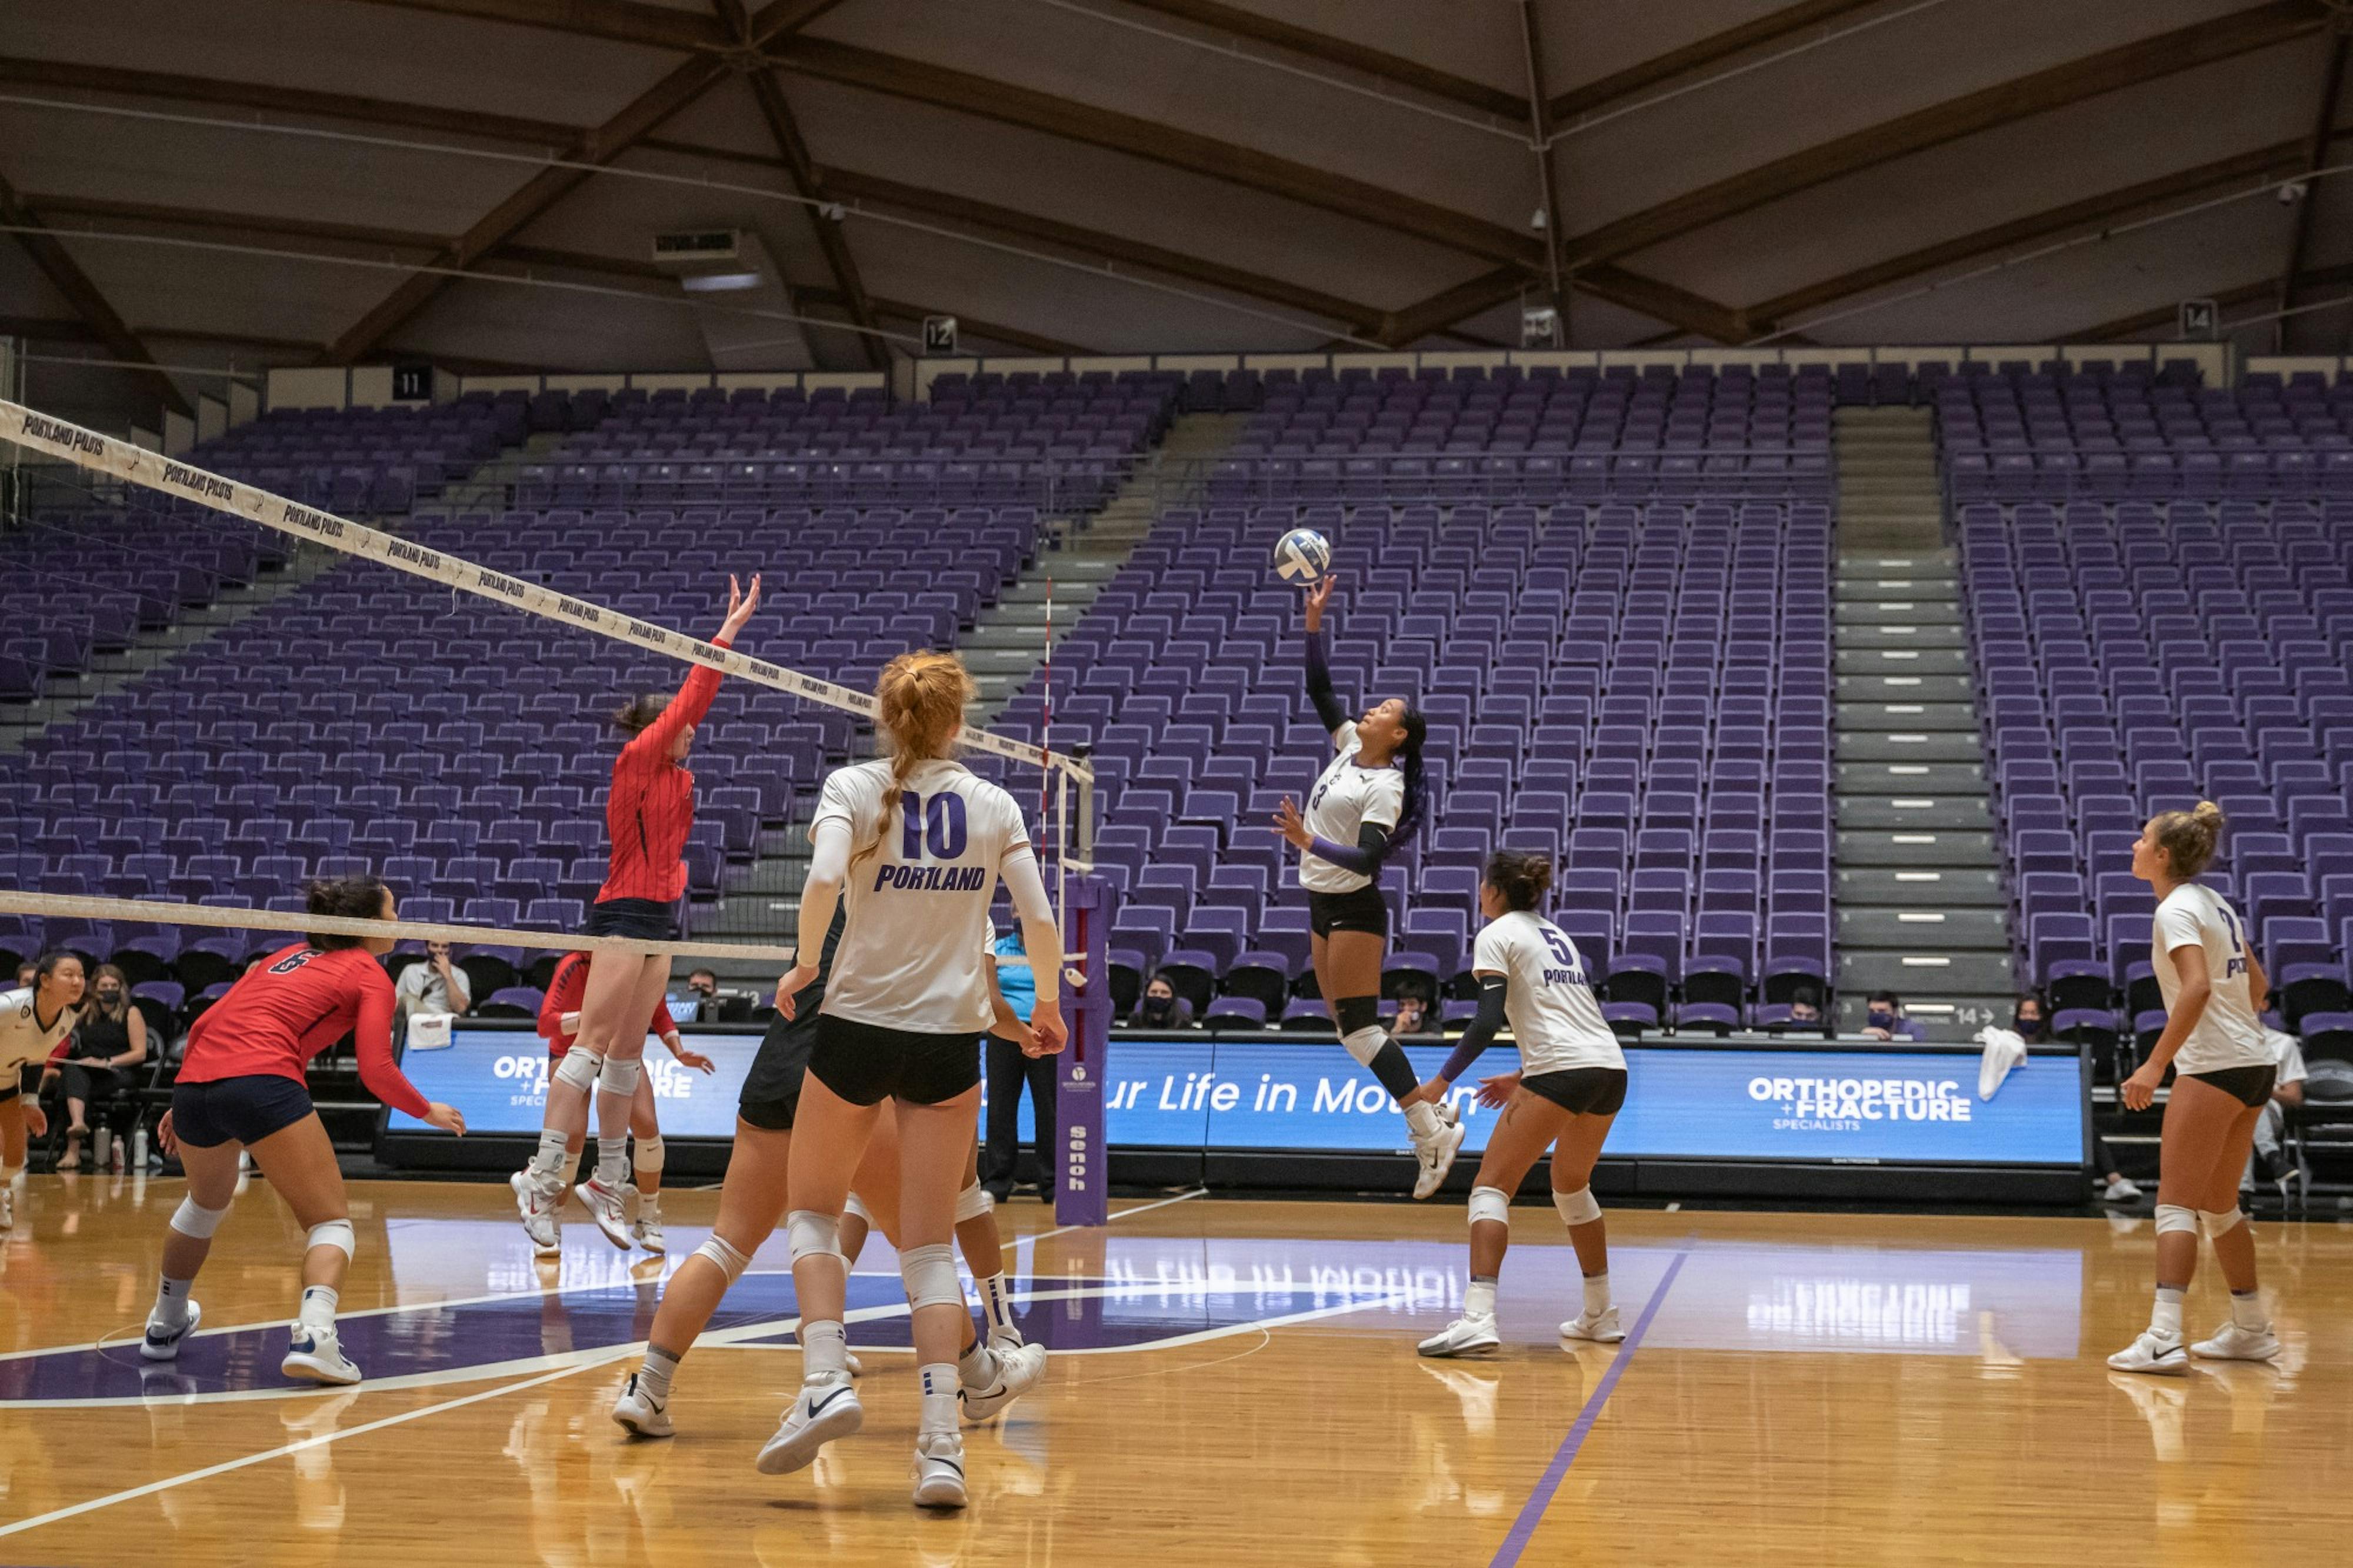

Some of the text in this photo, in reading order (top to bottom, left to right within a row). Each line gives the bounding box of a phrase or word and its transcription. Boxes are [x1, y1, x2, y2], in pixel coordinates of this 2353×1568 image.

[929, 324, 951, 345] 12
[402, 373, 418, 394] 11
[22, 413, 105, 456] PORTLAND PILOTS
[162, 463, 234, 501] PORTLAND PILOTS
[283, 504, 345, 538] PORTLAND PILOTS
[386, 541, 440, 569] PORTLAND PILOTS
[478, 571, 525, 598] PORTLAND PILOTS
[901, 790, 967, 860] 10
[873, 864, 985, 892] PORTLAND
[2216, 906, 2242, 953] 2
[1538, 928, 1574, 966] 5
[268, 949, 324, 975] 6
[1956, 1007, 1977, 1025] 14
[1158, 1072, 1240, 1112] Life
[1254, 1073, 1298, 1112] in
[1748, 1077, 1959, 1101] ORTHOPEDIC
[1772, 1119, 1861, 1131] SPECIALISTS
[1069, 1126, 1086, 1191] senoh
